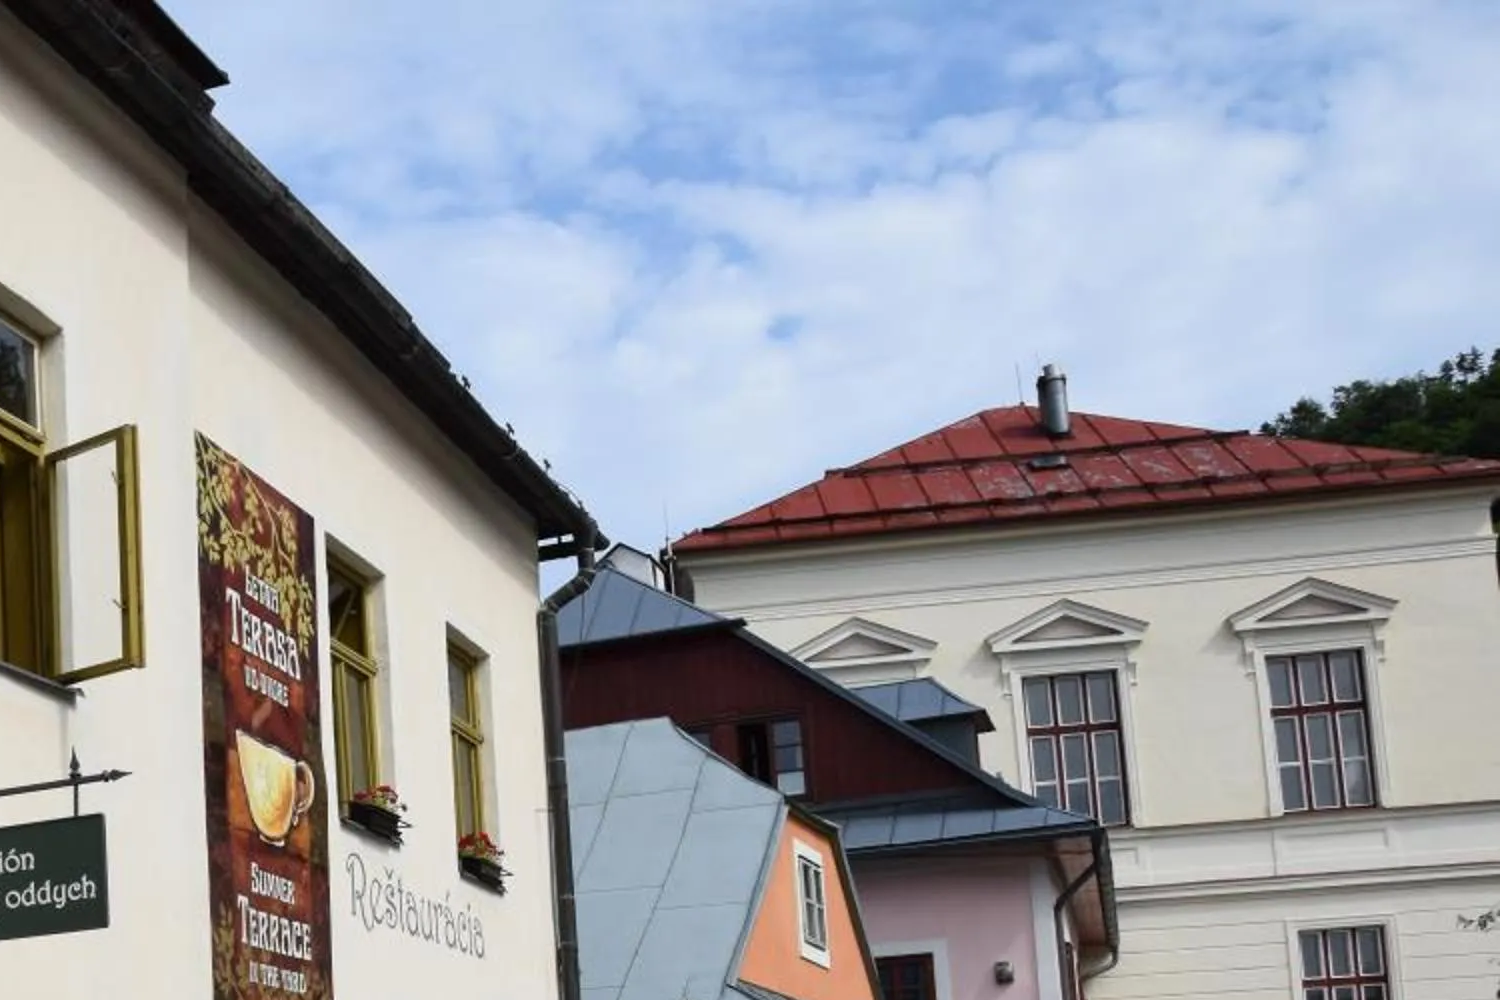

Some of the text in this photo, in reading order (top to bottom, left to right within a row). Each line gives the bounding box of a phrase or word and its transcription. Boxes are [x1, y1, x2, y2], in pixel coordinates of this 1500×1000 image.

[225, 586, 301, 681] TERASA
[5, 874, 97, 909] oddych
[237, 893, 312, 961] TERRACE
[345, 852, 485, 959] Reštaurácia
